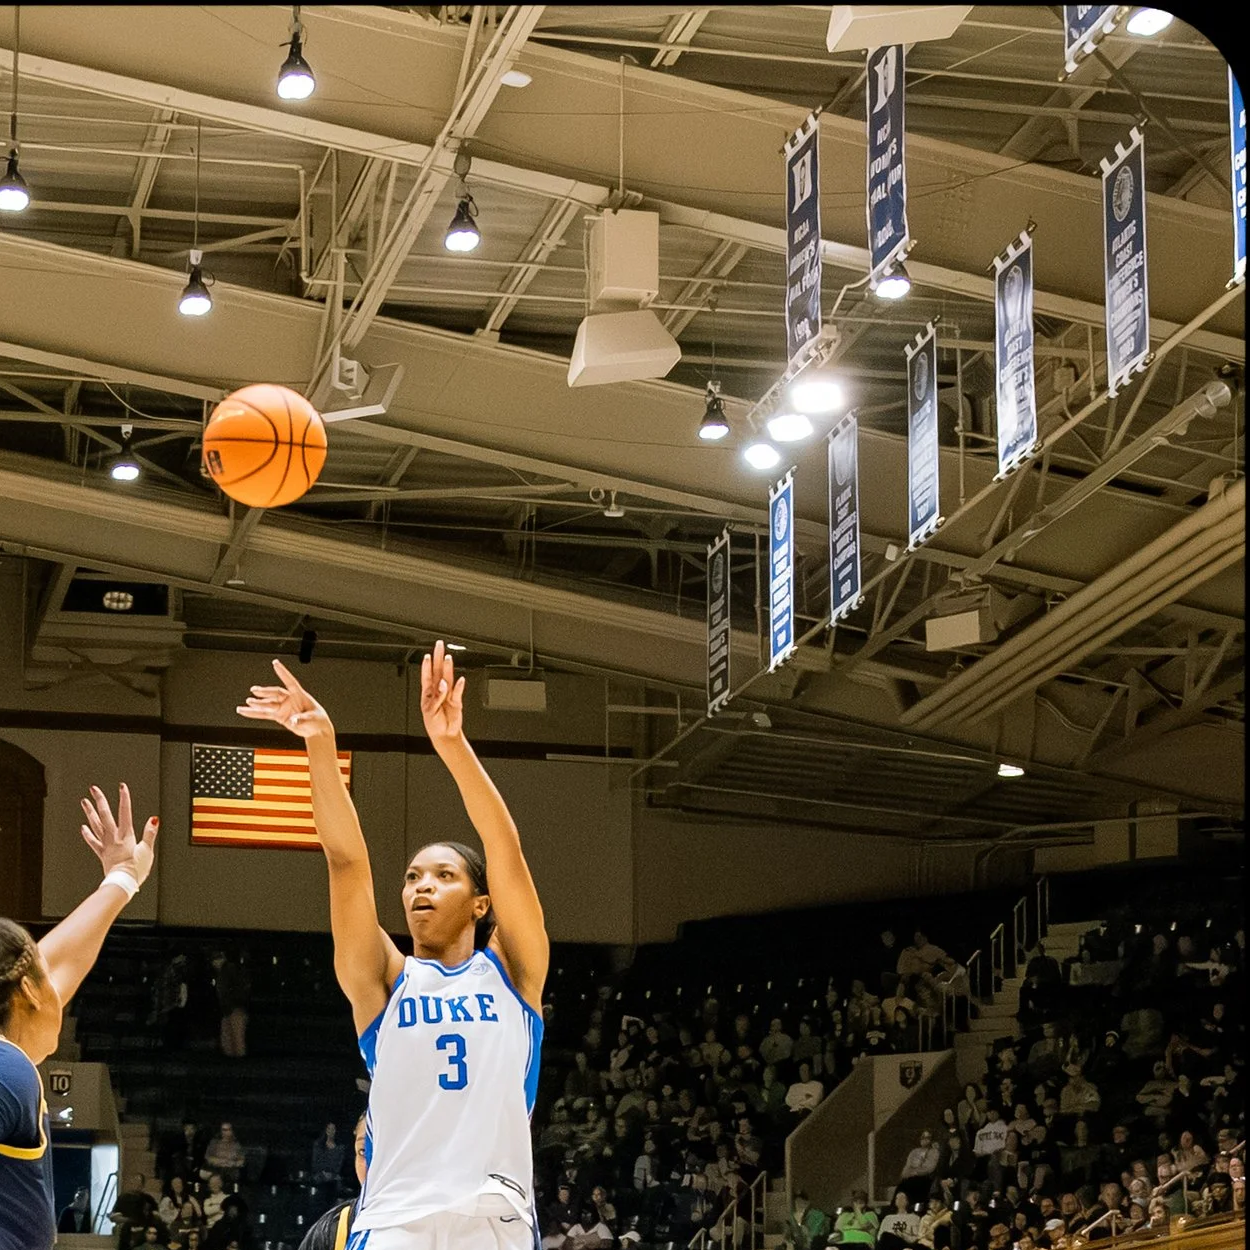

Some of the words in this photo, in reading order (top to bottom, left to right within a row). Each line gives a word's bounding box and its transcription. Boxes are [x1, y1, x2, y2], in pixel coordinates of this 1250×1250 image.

[398, 993, 499, 1028] DUKE
[435, 1033, 468, 1090] 3
[51, 1075, 69, 1092] 10
